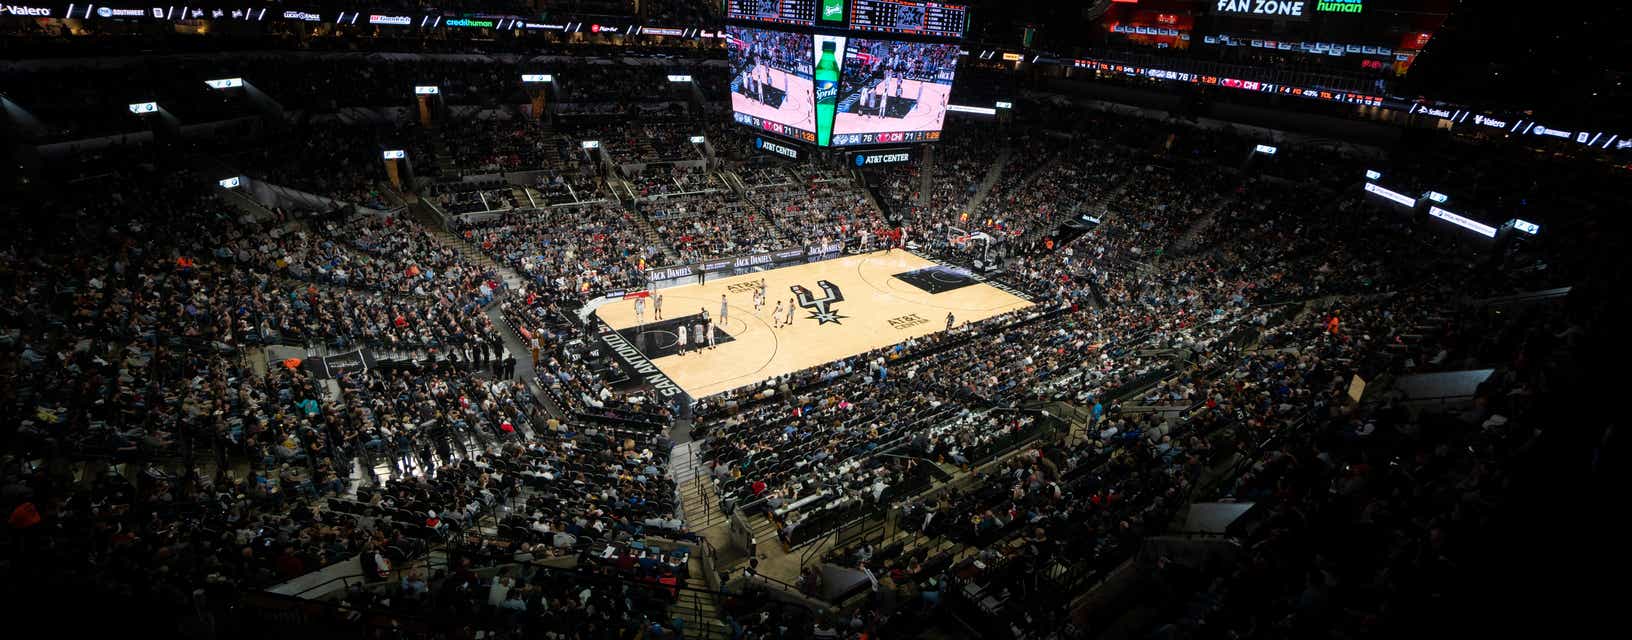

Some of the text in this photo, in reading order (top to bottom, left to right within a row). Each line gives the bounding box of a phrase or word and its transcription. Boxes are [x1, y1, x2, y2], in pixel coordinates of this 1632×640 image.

[7, 5, 50, 16] Valero
[1217, 0, 1304, 16] FAN ZONE
[1317, 1, 1363, 13] human
[1165, 70, 1176, 80] SA
[1177, 72, 1188, 81] 76
[1243, 80, 1258, 91] CHI
[1260, 83, 1273, 93] 71
[816, 87, 838, 100] Sprite
[1483, 117, 1506, 128] Valero
[784, 126, 792, 135] 71
[848, 135, 859, 143] SA
[891, 132, 903, 141] CHI
[904, 132, 914, 140] 71
[762, 141, 797, 159] AT&T CENTER
[865, 153, 909, 164] AT&T CENTER
[734, 257, 749, 268] JACK
[649, 266, 692, 281] JACK DANIEL'S
[988, 280, 1035, 300] SPURS
[887, 313, 921, 326] AT&T
[601, 334, 658, 374] ANTONIO
[645, 373, 682, 397] SAN
